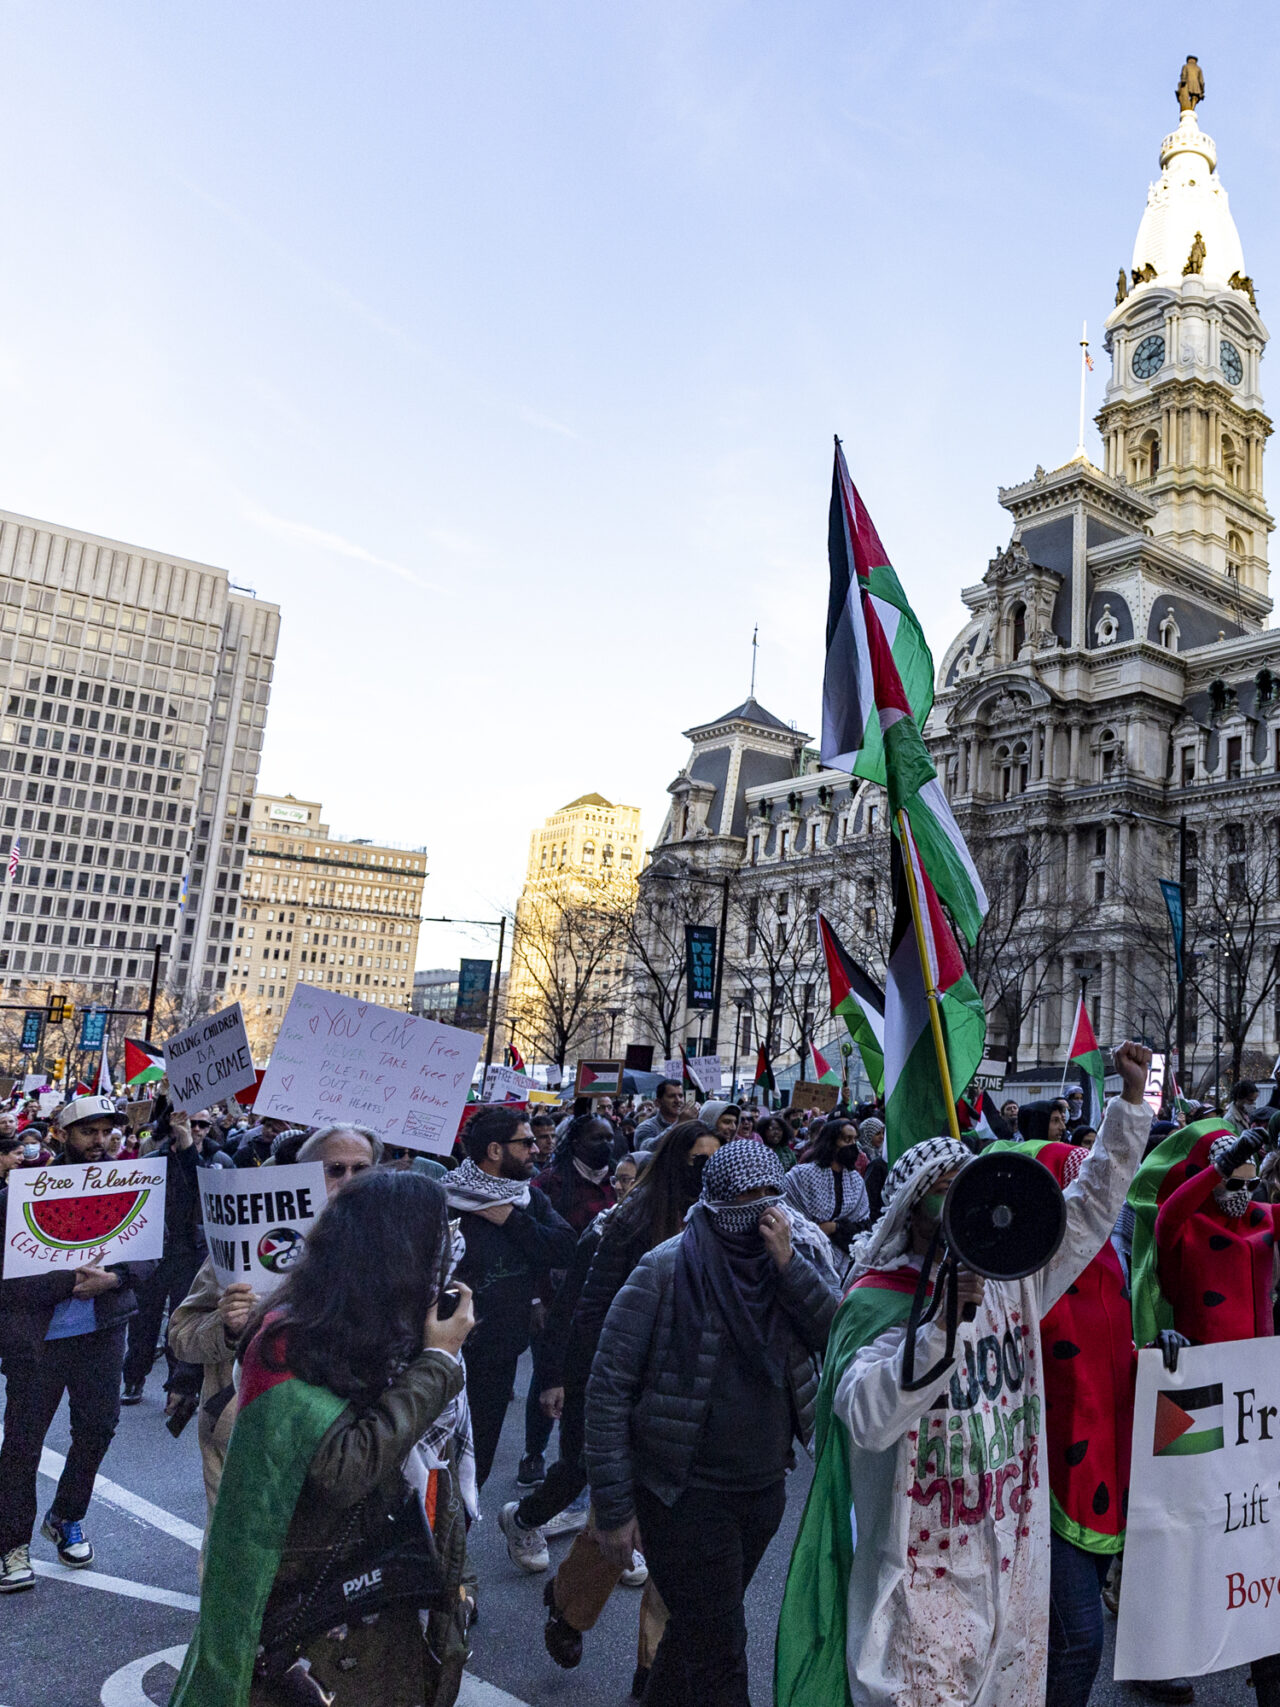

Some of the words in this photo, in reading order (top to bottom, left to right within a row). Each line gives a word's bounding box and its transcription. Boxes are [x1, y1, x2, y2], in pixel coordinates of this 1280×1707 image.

[168, 1032, 200, 1060] KILLING
[203, 1012, 239, 1041] CHILDREN
[323, 1006, 362, 1038] YOU
[369, 1021, 416, 1050] CAN
[208, 1044, 216, 1058] A
[428, 1035, 460, 1059] Free
[380, 1052, 407, 1069] TAKE
[419, 1064, 447, 1080] Free
[173, 1072, 204, 1103] WAR
[207, 1045, 250, 1086] CRIME
[319, 1076, 351, 1091] OUT
[968, 1076, 1003, 1090] STINE
[266, 1094, 295, 1112] Free
[319, 1090, 342, 1104] OUR
[311, 1108, 337, 1123] Free
[82, 1166, 164, 1191] Palestine
[203, 1188, 314, 1226] CEASEFIRE
[10, 1231, 112, 1262] CEASEFIRE
[117, 1213, 148, 1245] NOW
[1223, 1483, 1269, 1534] Lift
[343, 1568, 382, 1596] PYLE
